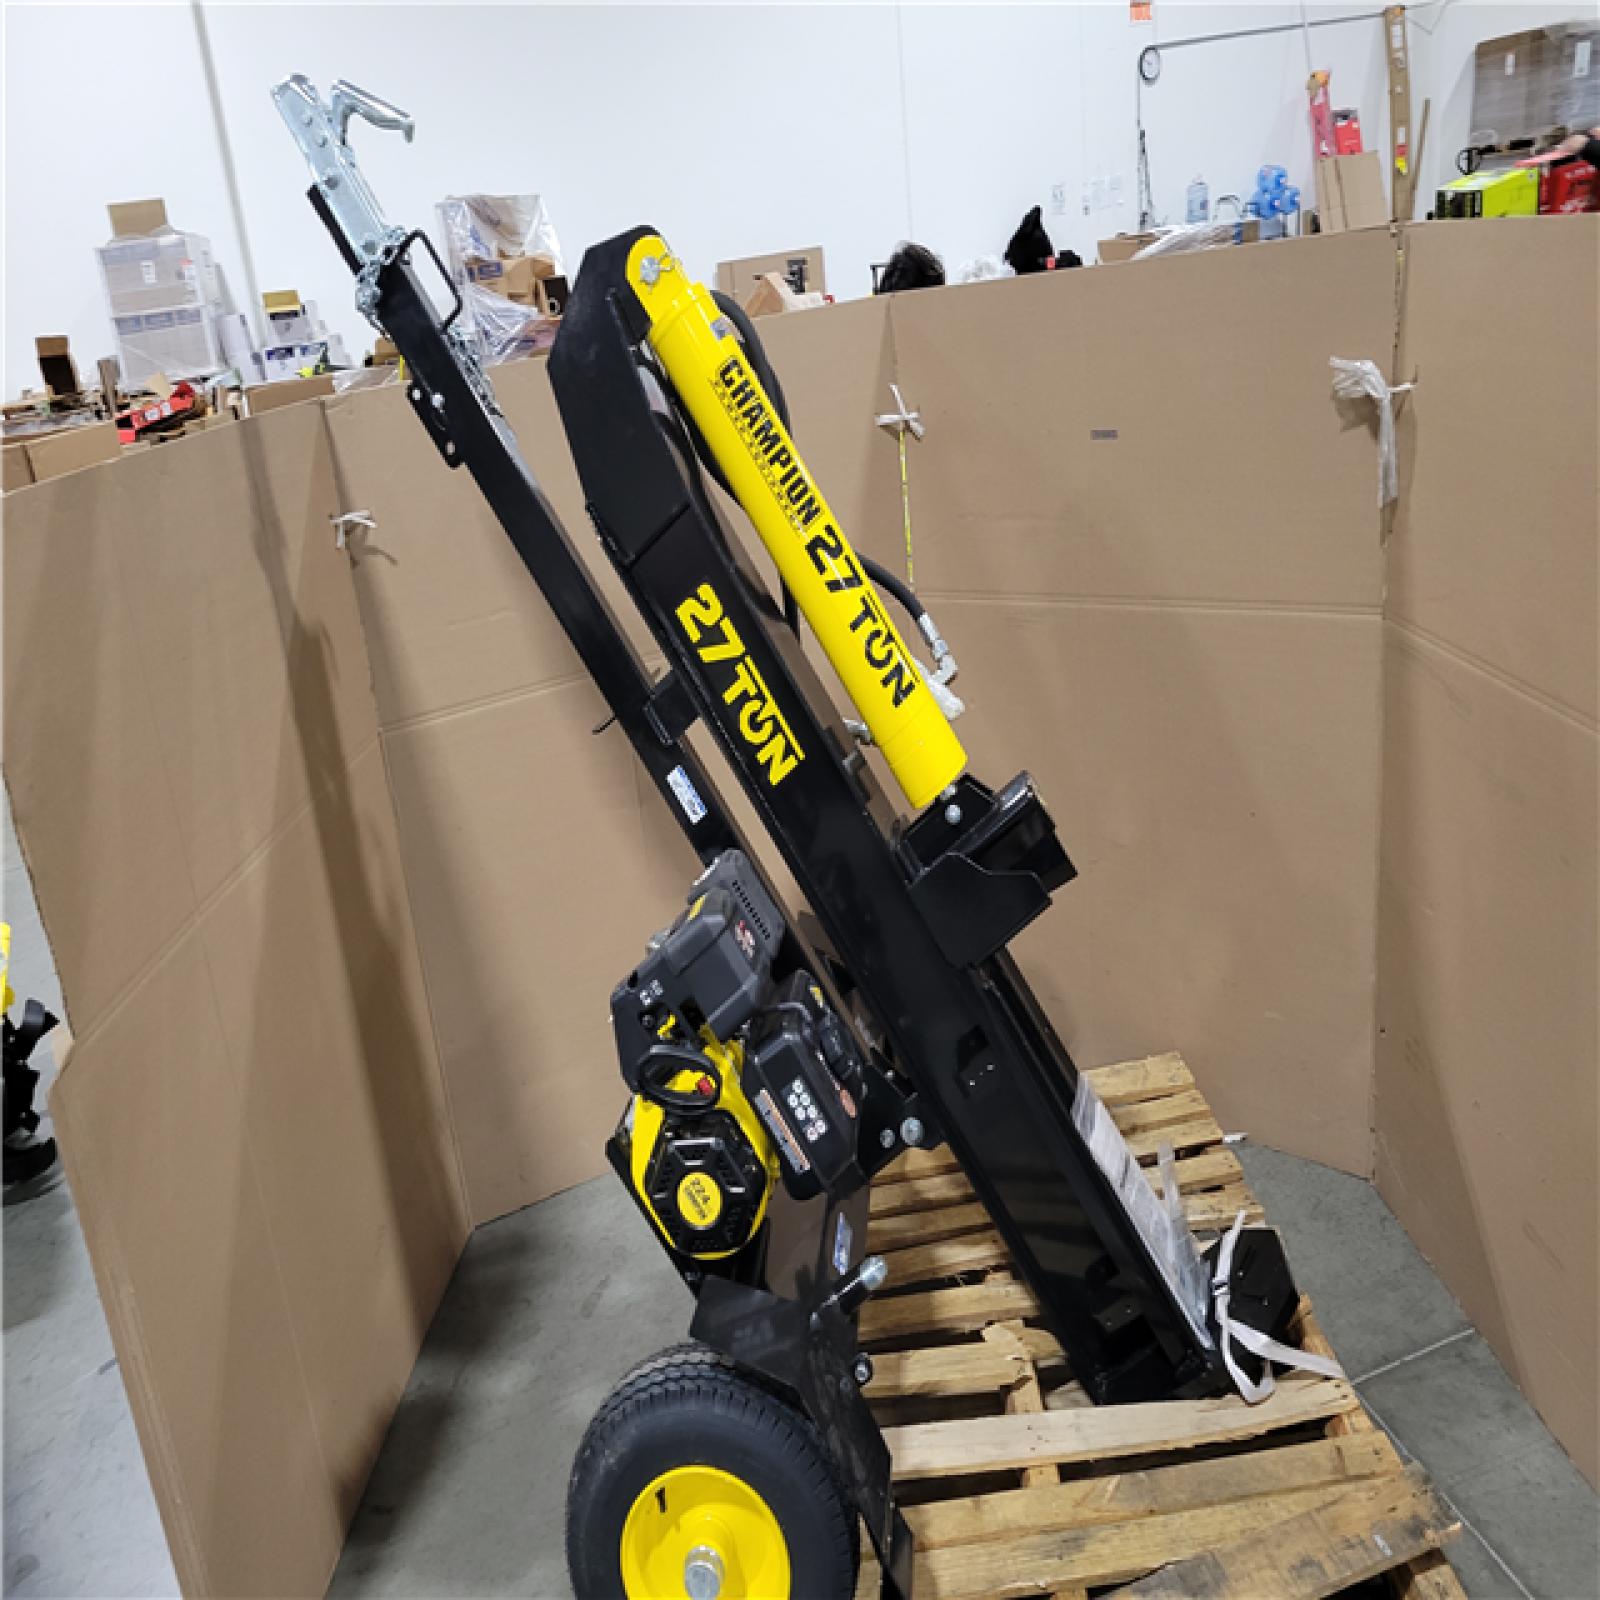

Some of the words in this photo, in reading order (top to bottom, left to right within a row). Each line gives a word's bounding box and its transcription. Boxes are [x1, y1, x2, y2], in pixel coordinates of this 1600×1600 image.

[719, 358, 821, 525] CHAMPION
[805, 524, 864, 593] 27
[850, 592, 918, 708] TON
[675, 583, 746, 664] 27
[722, 656, 802, 786] TON
